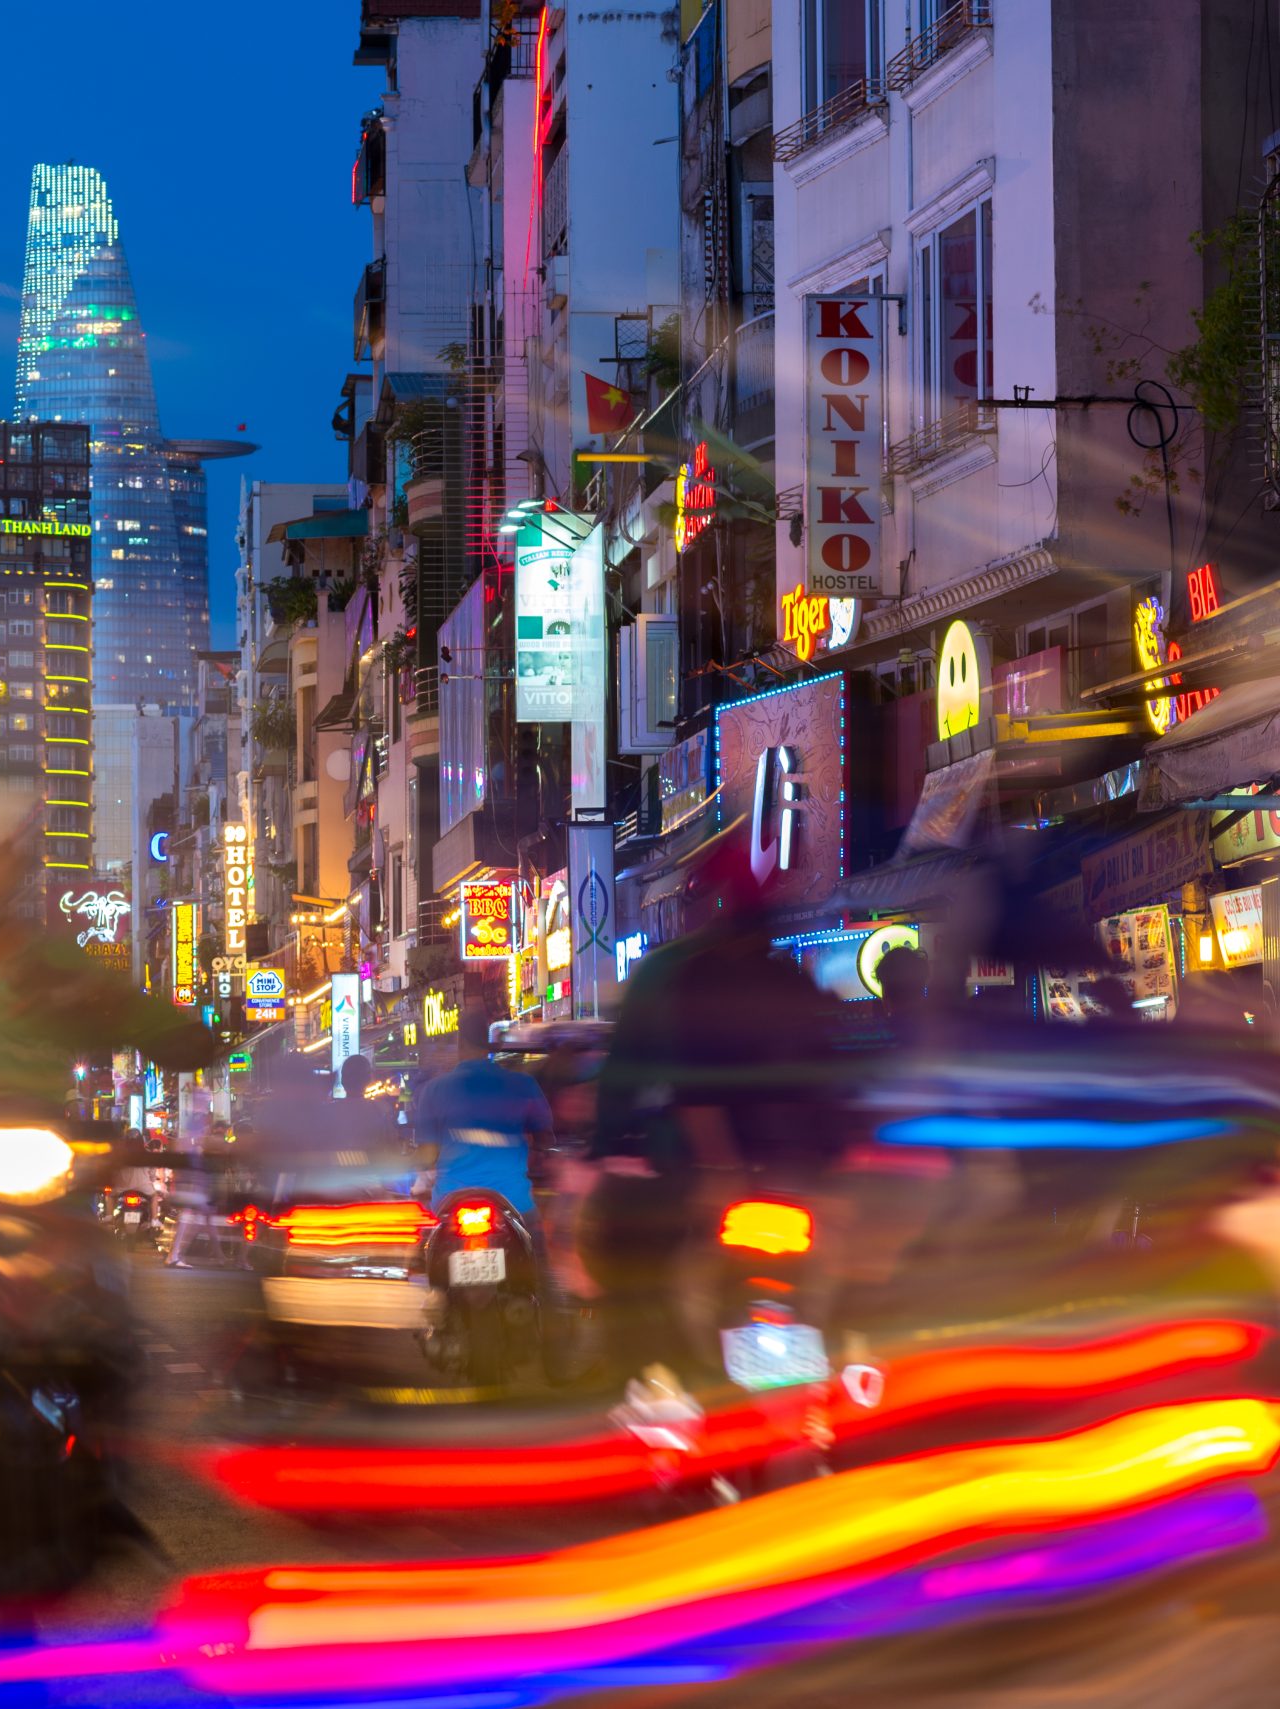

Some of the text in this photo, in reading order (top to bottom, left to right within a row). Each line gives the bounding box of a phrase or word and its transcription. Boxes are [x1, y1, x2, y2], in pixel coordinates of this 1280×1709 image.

[816, 300, 875, 572] KONIKO
[2, 519, 53, 535] THANH
[54, 521, 92, 537] LAND
[812, 575, 878, 590] HOSTEL
[1187, 564, 1218, 623] BIA
[781, 583, 828, 661] Tiger
[224, 825, 247, 842] 99
[225, 846, 247, 948] HOTEL
[468, 898, 508, 919] BBQ
[255, 1008, 277, 1019] 24H
